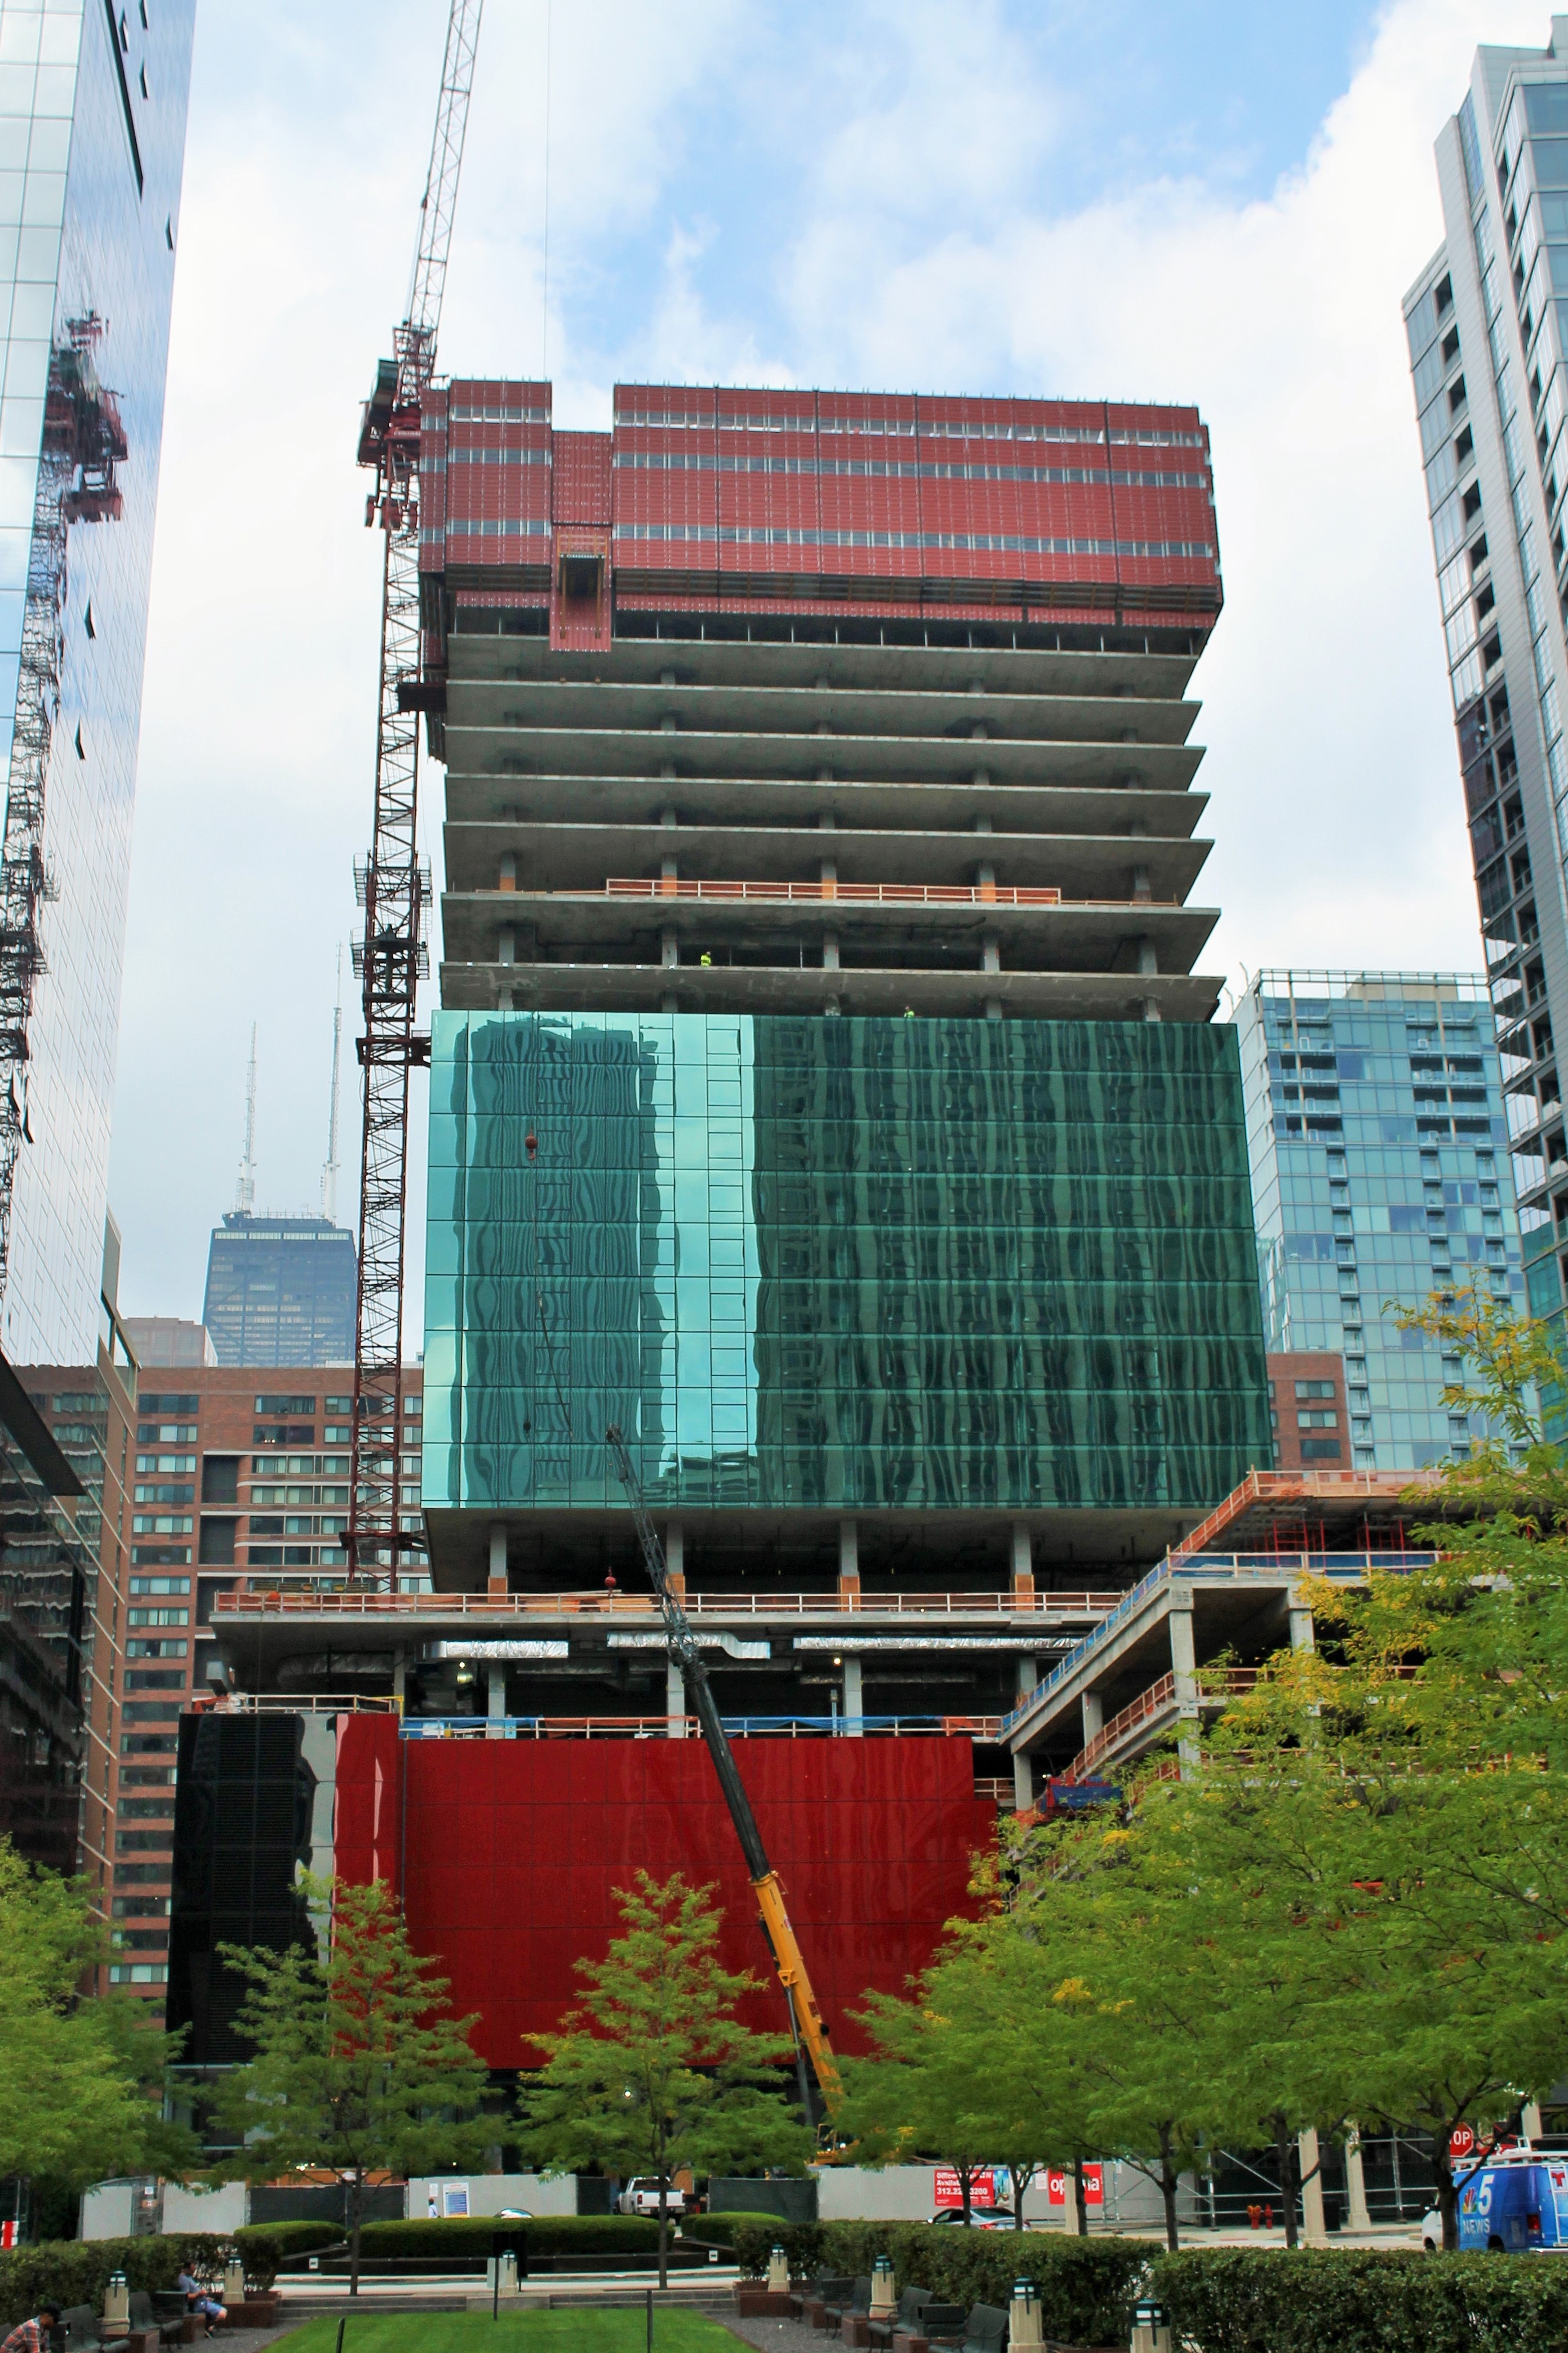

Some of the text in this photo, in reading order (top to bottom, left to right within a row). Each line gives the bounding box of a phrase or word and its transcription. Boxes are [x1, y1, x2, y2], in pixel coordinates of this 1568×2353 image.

[1450, 2130, 1471, 2145] OP
[1478, 2174, 1495, 2216] 5
[1463, 2218, 1491, 2234] NEWS
